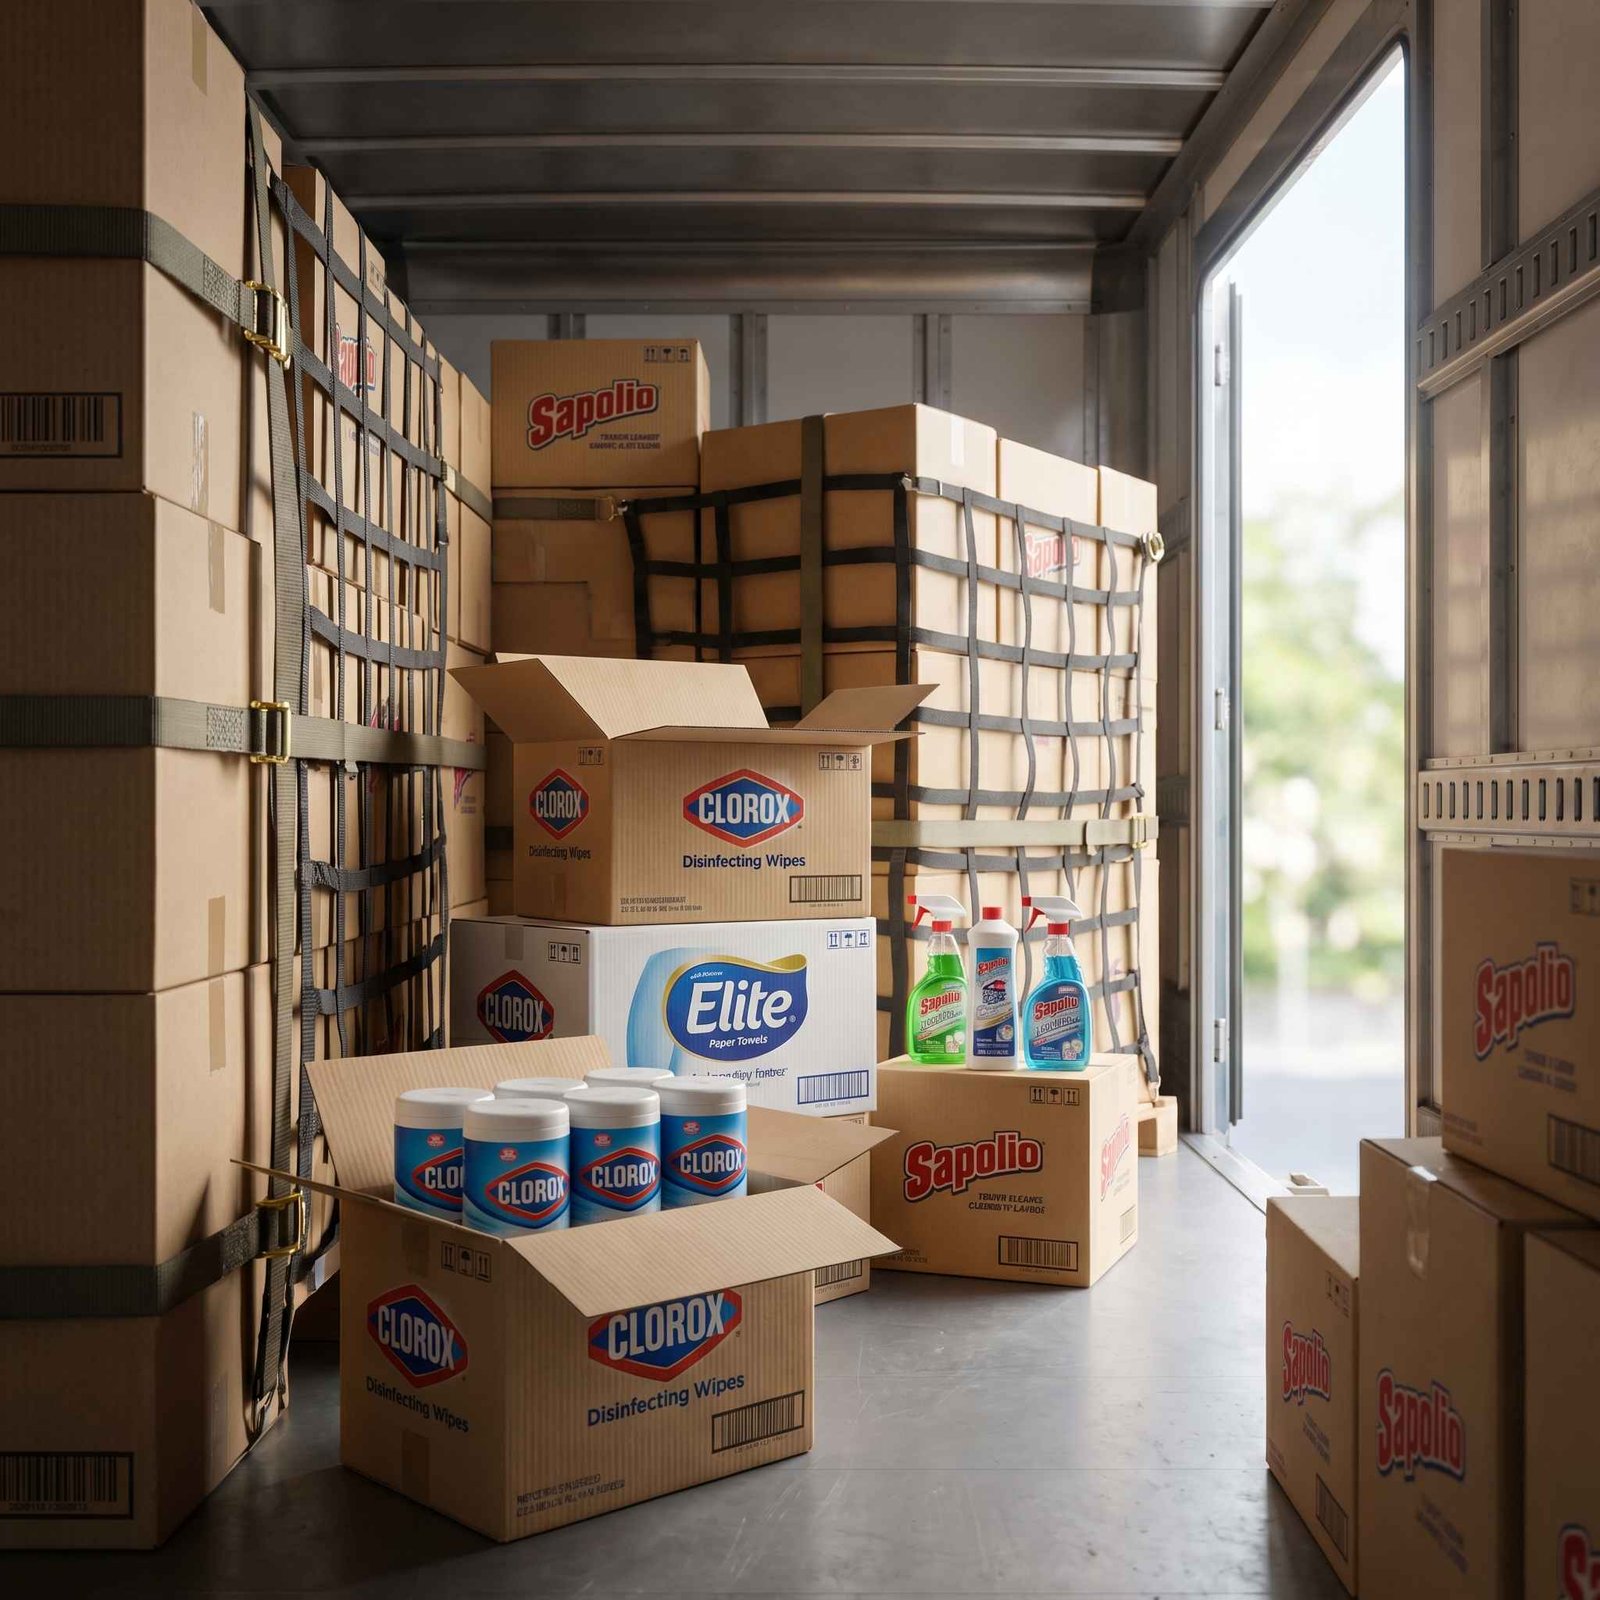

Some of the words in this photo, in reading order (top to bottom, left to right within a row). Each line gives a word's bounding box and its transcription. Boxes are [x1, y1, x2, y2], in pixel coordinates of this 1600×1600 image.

[528, 379, 658, 449] Sapolio
[535, 790, 582, 818] CLOROX
[698, 793, 790, 824] CLOROX
[529, 845, 568, 860] Disinfecting
[570, 846, 591, 860] Wipes
[683, 854, 761, 870] Disinfecting
[766, 854, 806, 869] Wipes
[485, 992, 544, 1034] CLOROX
[686, 979, 793, 1035] Elite
[1474, 942, 1575, 1062] Sapolio
[709, 1038, 736, 1050] Paper
[738, 1034, 768, 1047] Towels
[424, 1166, 463, 1190] CLO
[591, 1161, 656, 1188] CLOROX
[680, 1149, 742, 1174] CLOROX
[904, 1131, 1043, 1202] Sapolio
[498, 1176, 564, 1205] CLOROX
[378, 1304, 455, 1370] CLOROX
[608, 1293, 725, 1361] CLOROX
[1282, 1320, 1331, 1405] Sapolio
[366, 1375, 430, 1420] Disinfecting
[432, 1403, 469, 1433] Wipes
[588, 1388, 689, 1427] Disinfecting
[694, 1374, 745, 1399] Wipes
[1376, 1368, 1466, 1483] Sapolio
